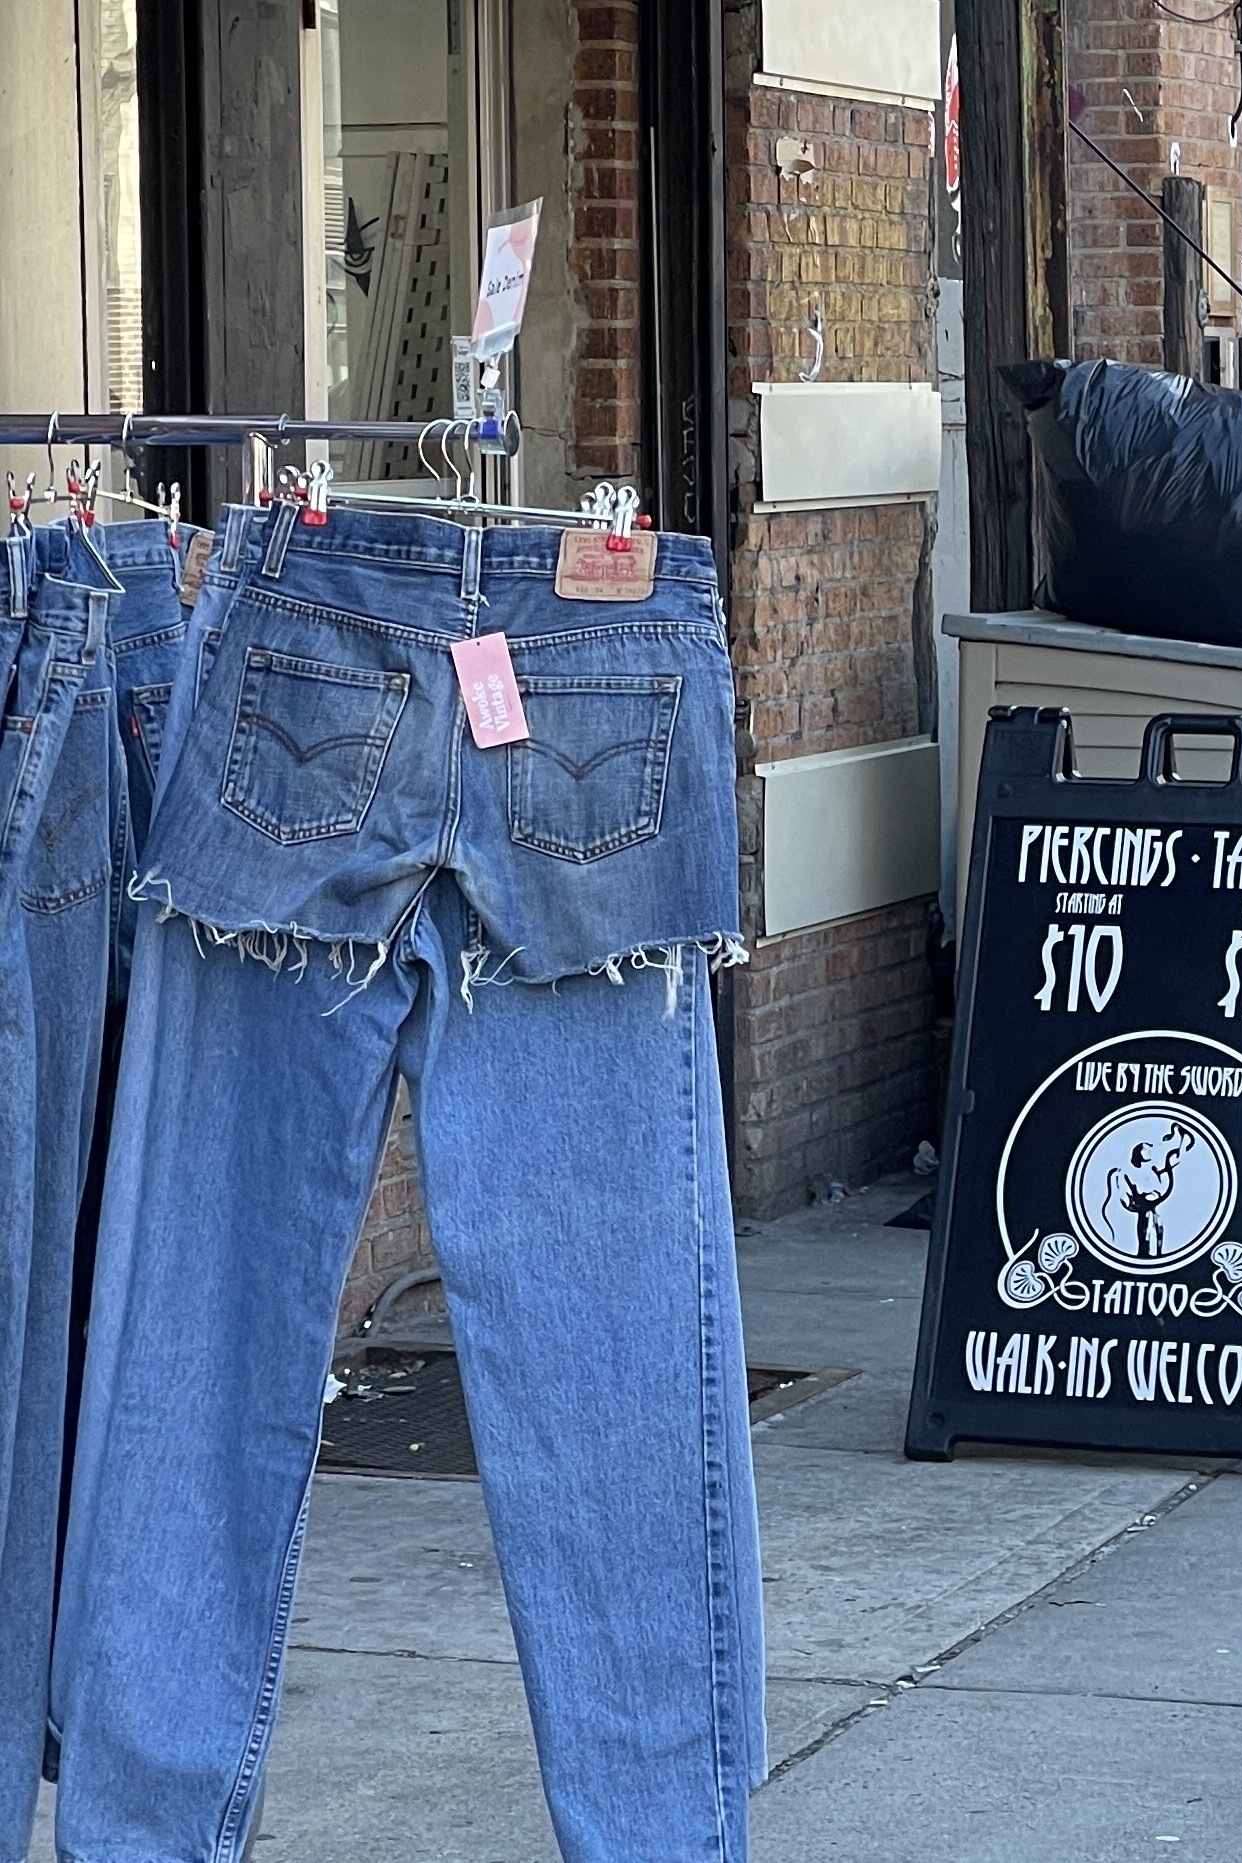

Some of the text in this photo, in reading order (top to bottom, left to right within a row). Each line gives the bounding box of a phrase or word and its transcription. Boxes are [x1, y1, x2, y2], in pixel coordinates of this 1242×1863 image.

[471, 681, 495, 730] Awoke
[487, 673, 511, 733] Vintage
[1018, 824, 1183, 887] PIERCINGS
[1054, 891, 1124, 915] STARTING AT
[1033, 923, 1124, 1013] $10
[1075, 1061, 1112, 1092] LIVE
[1115, 1062, 1141, 1093] BY
[1144, 1063, 1175, 1095] THE
[1091, 1279, 1189, 1318] TATTOO
